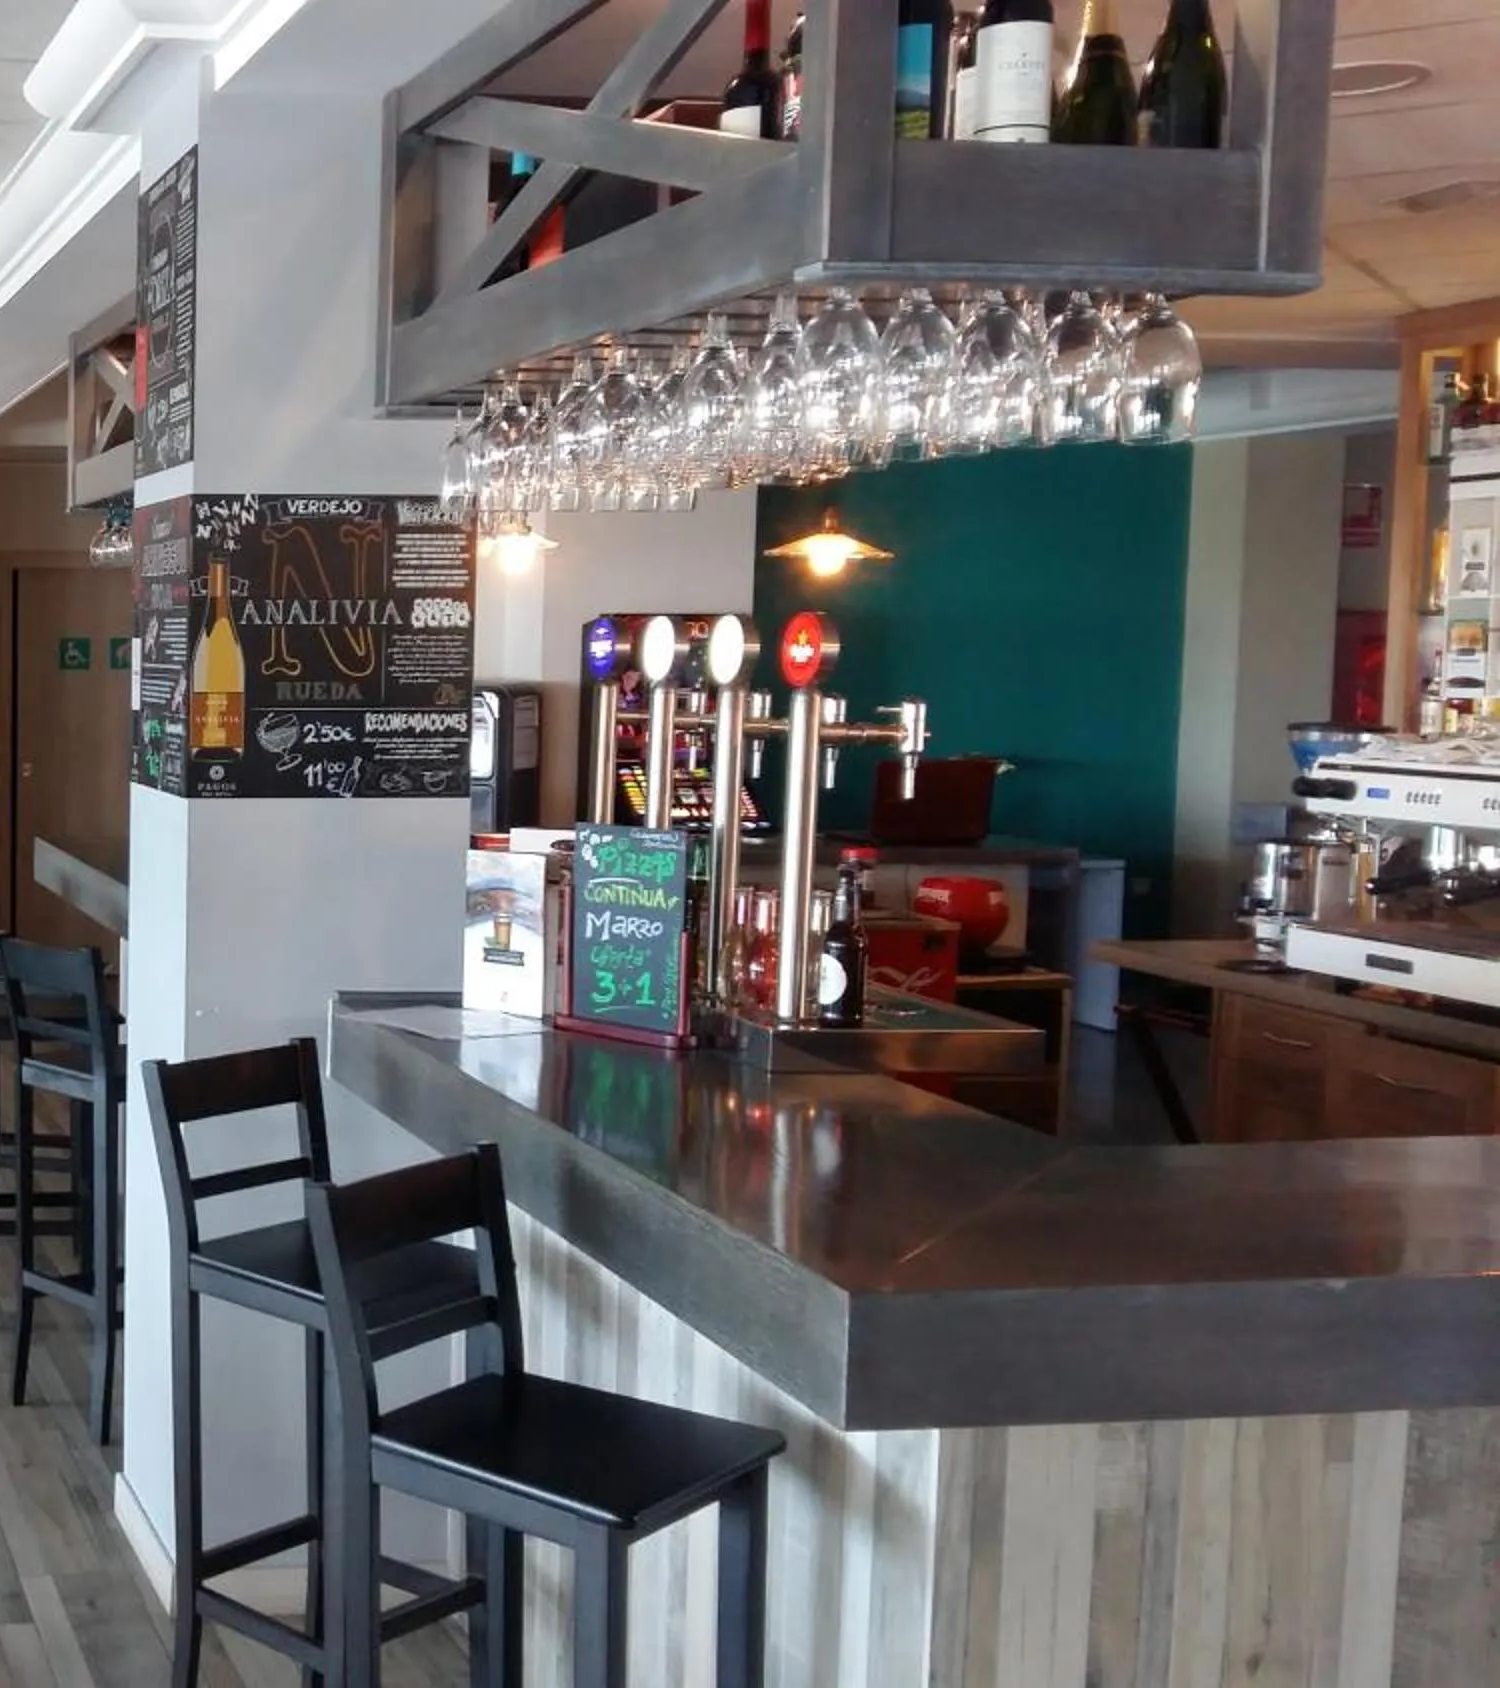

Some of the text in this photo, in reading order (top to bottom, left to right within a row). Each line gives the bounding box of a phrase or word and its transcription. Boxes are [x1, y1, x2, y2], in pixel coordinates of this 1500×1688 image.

[286, 499, 363, 515] VERDEJO
[239, 599, 403, 625] ANALIVIA
[276, 681, 364, 701] RUEDA
[584, 883, 665, 909] CONTINUA
